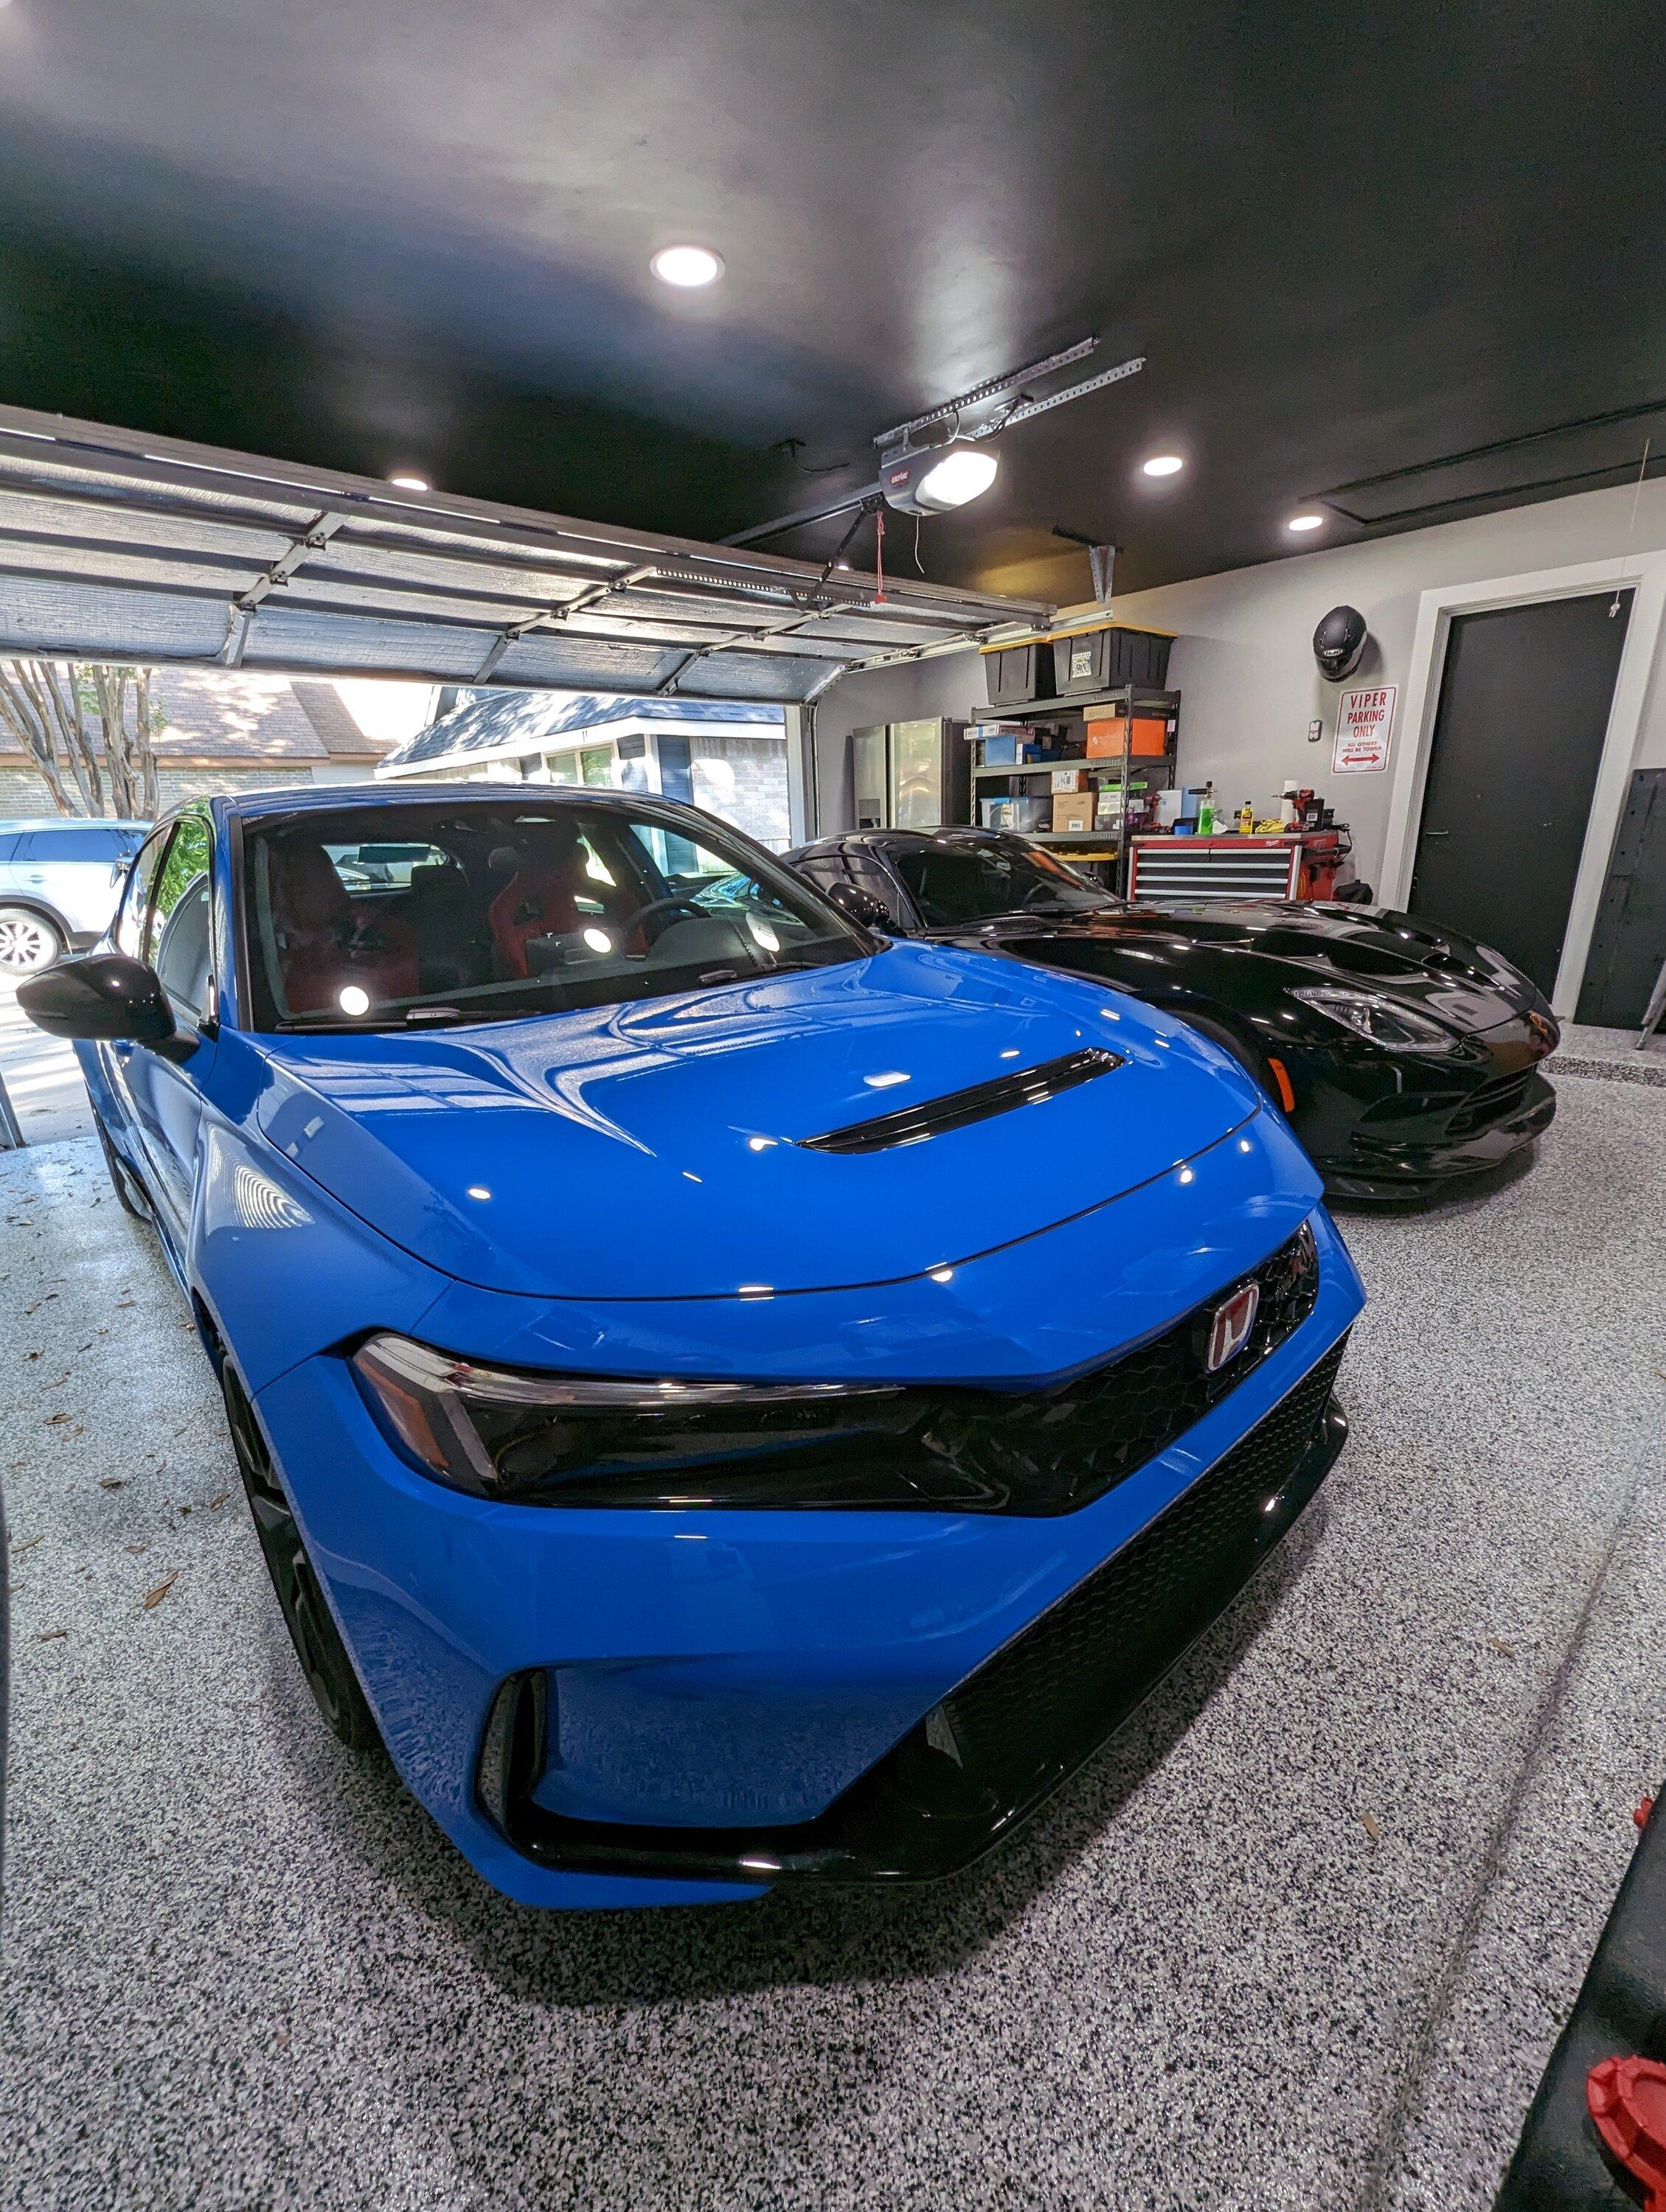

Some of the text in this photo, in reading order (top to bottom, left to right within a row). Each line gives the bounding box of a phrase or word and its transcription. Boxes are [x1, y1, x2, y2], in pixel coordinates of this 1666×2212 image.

[1350, 692, 1386, 709] VIPER
[1347, 709, 1385, 724] PARKING
[1353, 725, 1375, 737] ONLY
